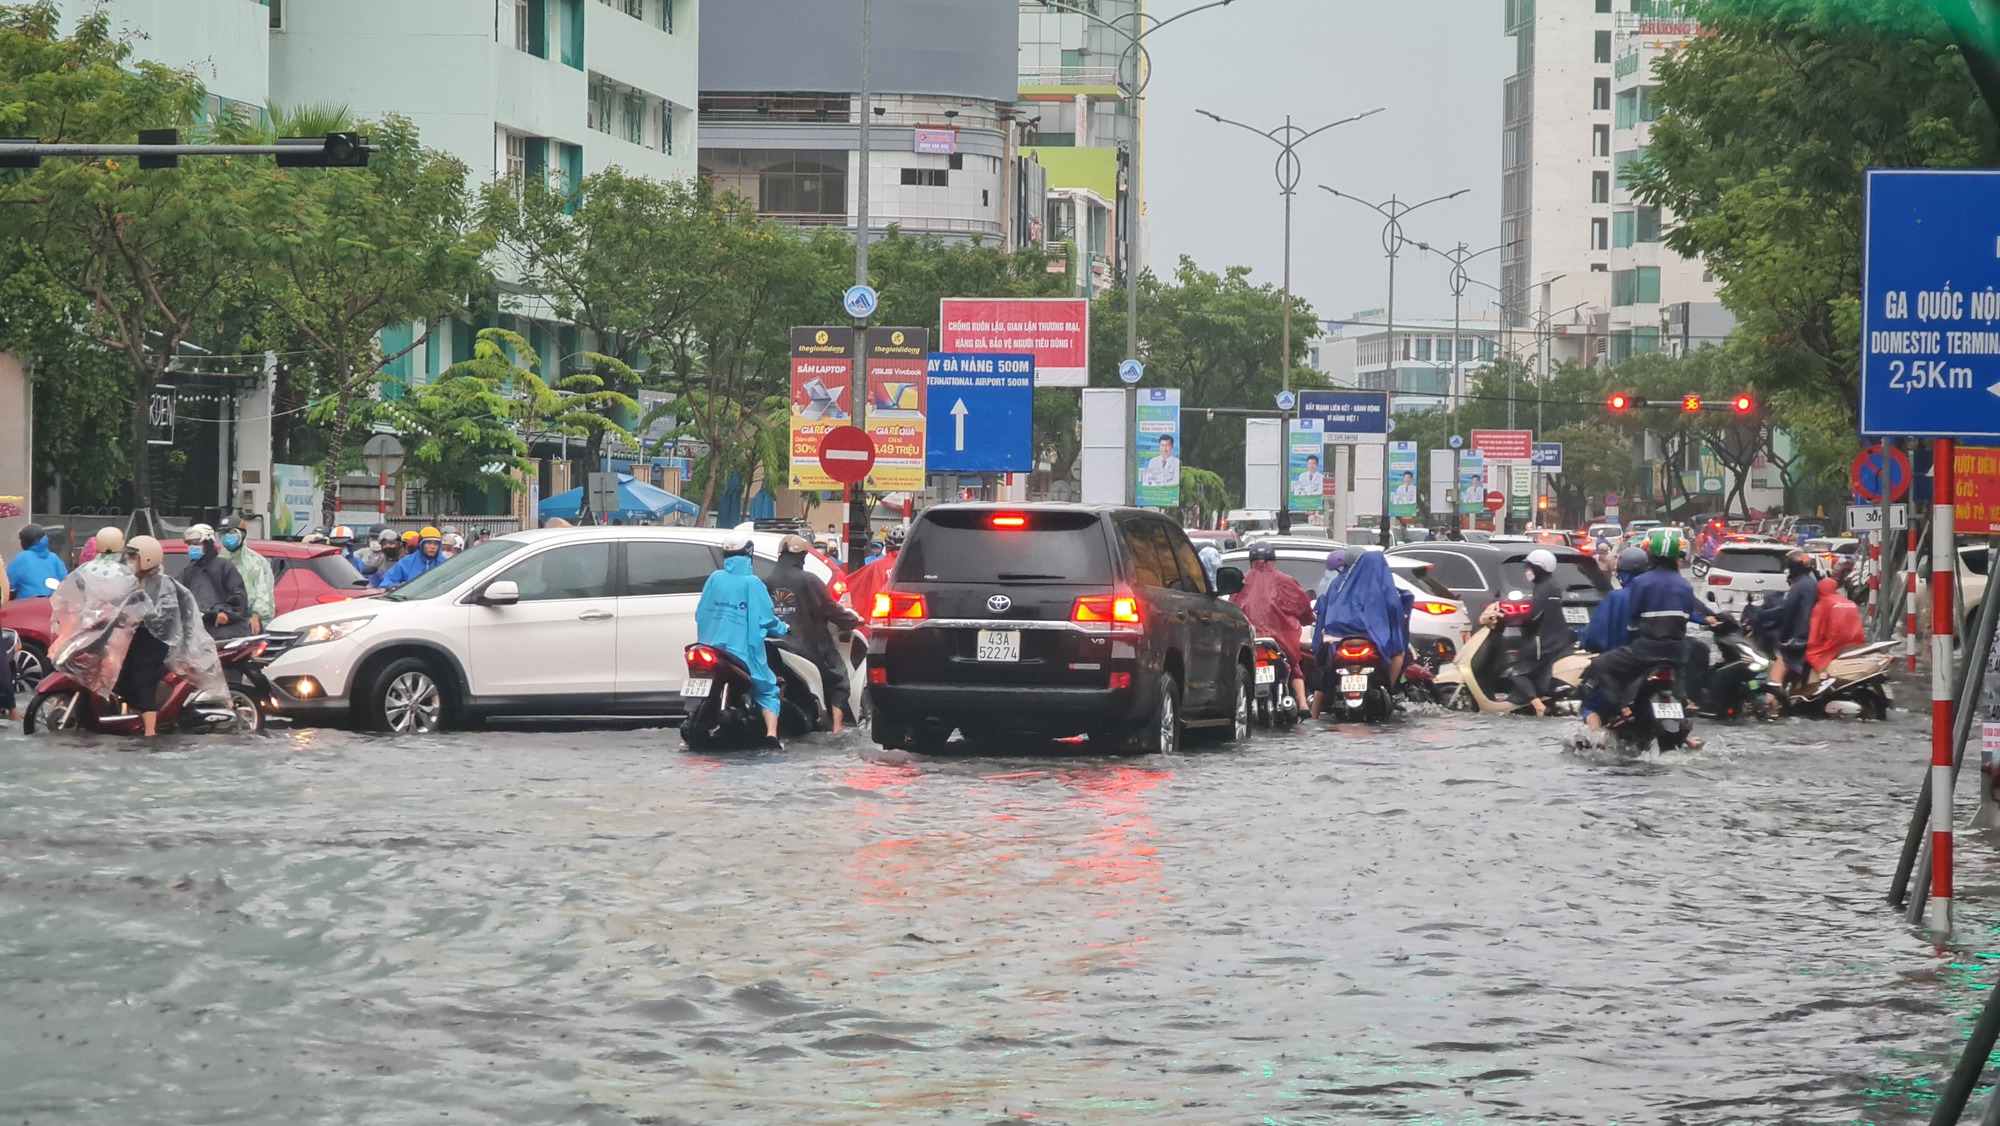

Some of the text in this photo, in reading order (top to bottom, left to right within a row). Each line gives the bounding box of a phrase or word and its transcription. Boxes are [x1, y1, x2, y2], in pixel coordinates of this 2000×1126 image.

[1886, 290, 1908, 319] GA
[1917, 280, 1963, 322] QUỐC
[948, 319, 971, 332] CHỐNG
[971, 320, 990, 332] BUÔN
[1006, 322, 1024, 332] GIAN
[1024, 320, 1038, 333] LẬN
[1038, 321, 1064, 332] THƯƠNG
[798, 345, 845, 354] thegioididong
[955, 336, 974, 348] HÀNG
[989, 337, 1003, 348] BẢO
[1003, 337, 1013, 350] VỆ
[1034, 337, 1049, 348] TIÊU
[1050, 337, 1069, 349] DÙNG
[1871, 331, 1941, 354] DOMESTIC
[874, 346, 921, 355] thegioididong
[816, 365, 846, 374] LAPTOP
[943, 356, 959, 372] ĐÀ
[998, 360, 1030, 373] 500M
[894, 368, 922, 376] Vivobook
[1889, 360, 1973, 395] 2,5Km
[975, 377, 1005, 387] AIRPORT
[1007, 378, 1029, 387] 500M
[794, 443, 817, 454] 30%
[895, 443, 920, 457] TRIỆU
[1866, 512, 1882, 522] 30
[988, 632, 1010, 646] 43A
[980, 646, 1017, 660] 522.74
